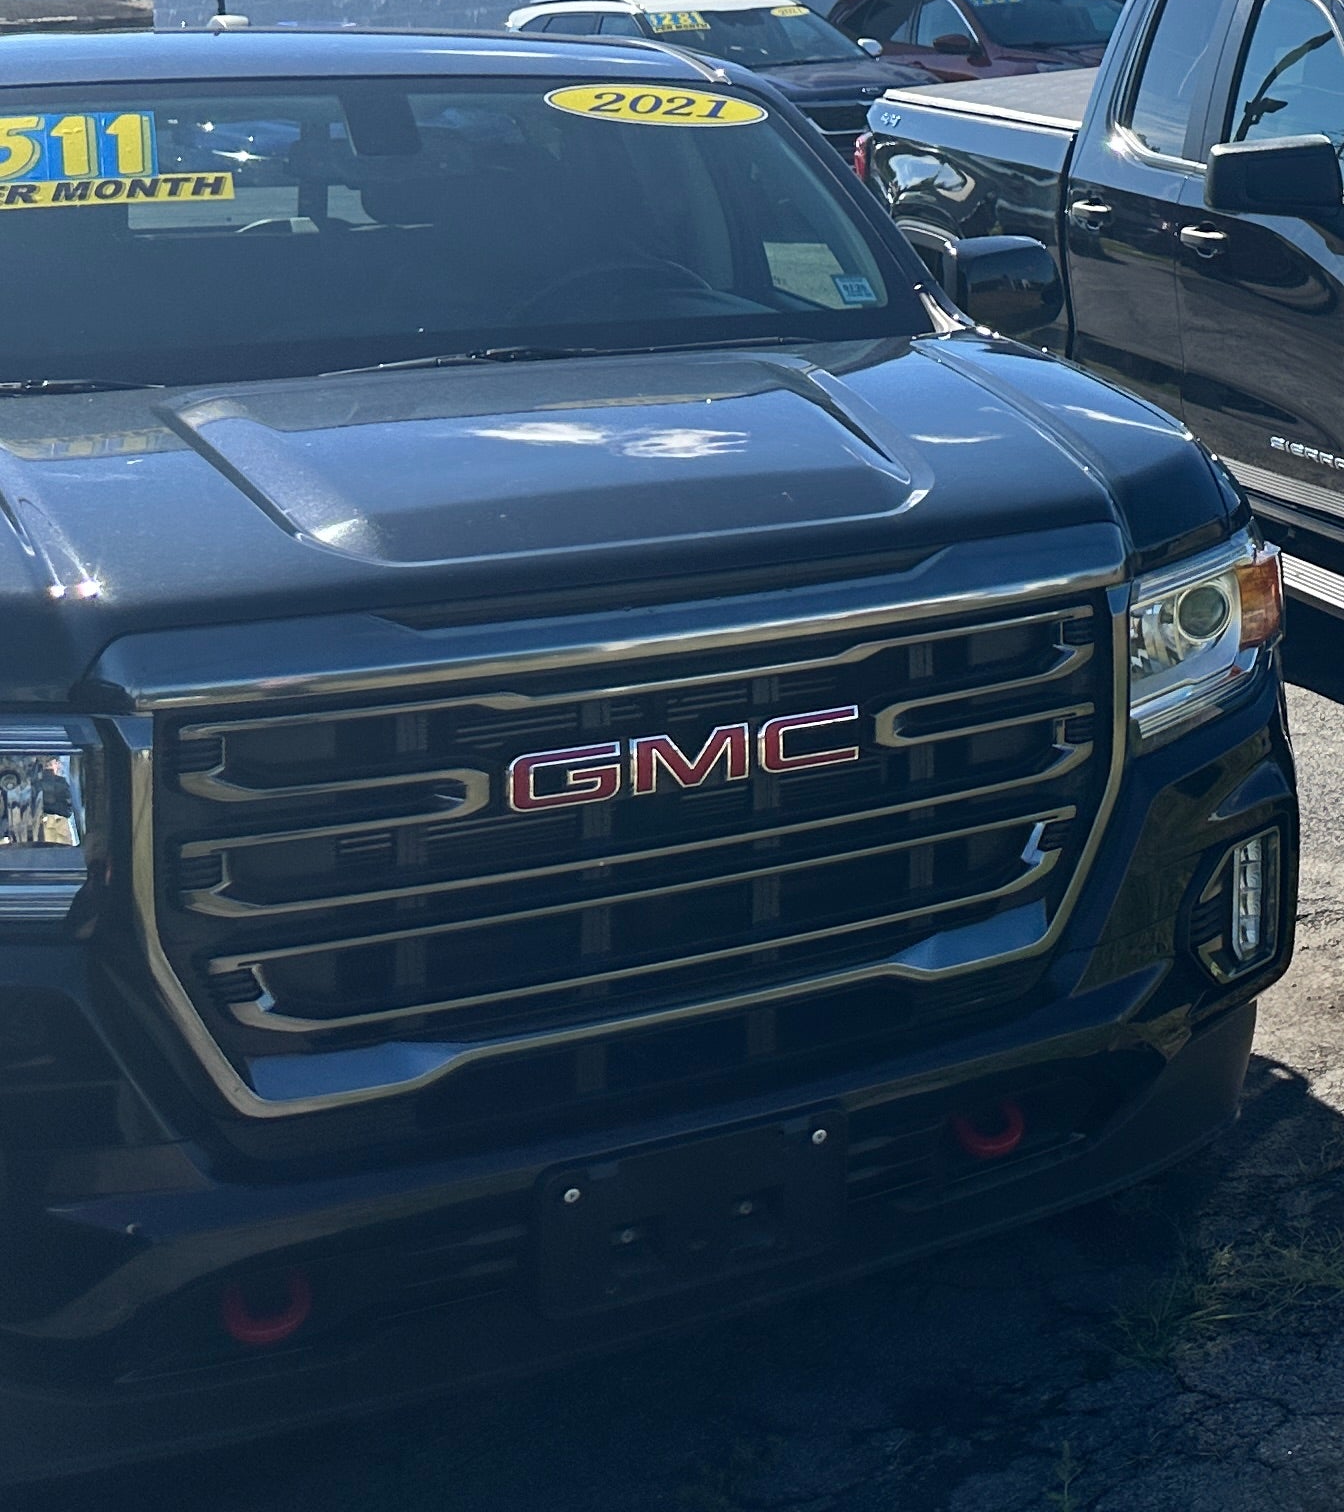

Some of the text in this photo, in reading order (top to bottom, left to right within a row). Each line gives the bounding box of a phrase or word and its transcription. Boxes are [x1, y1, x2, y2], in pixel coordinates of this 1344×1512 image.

[588, 90, 726, 120] 2021
[0, 113, 152, 180] 511
[51, 176, 227, 202] MONTH
[507, 703, 861, 813] GMC
